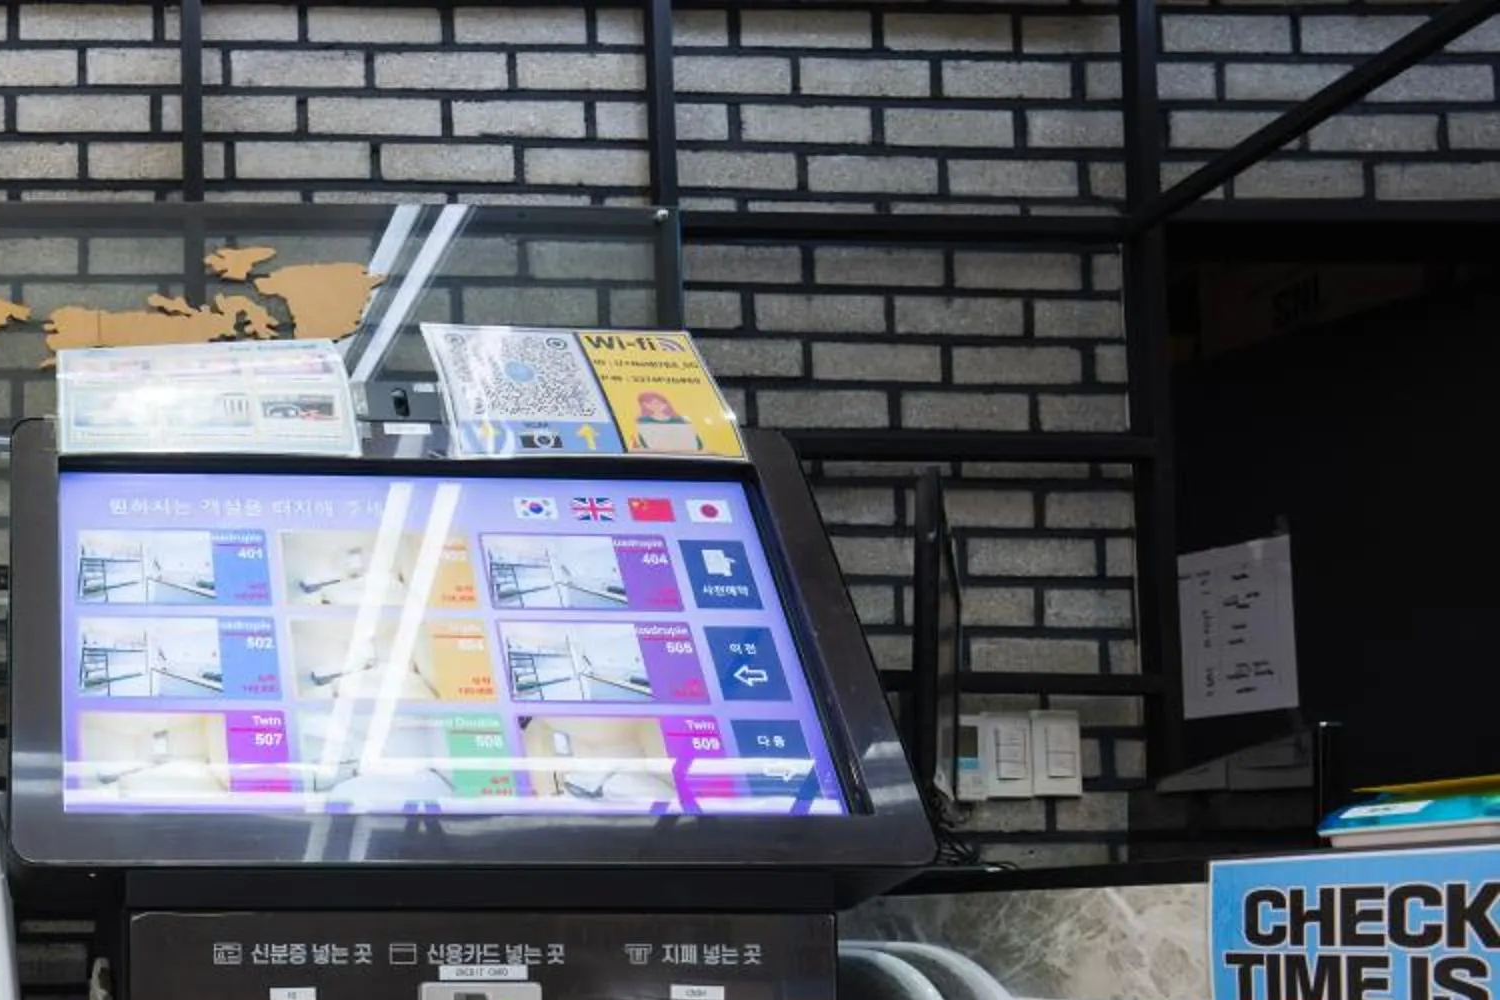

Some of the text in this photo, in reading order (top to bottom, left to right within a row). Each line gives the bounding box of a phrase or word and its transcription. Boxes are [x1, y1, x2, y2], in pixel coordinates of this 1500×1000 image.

[251, 715, 281, 728] Twin
[1244, 881, 1500, 951] CHECK
[251, 943, 373, 965] 신분증 넣는 곳
[428, 943, 566, 965] 신용카드 넣는 곳
[661, 943, 762, 965] 지폐 넣는 곳
